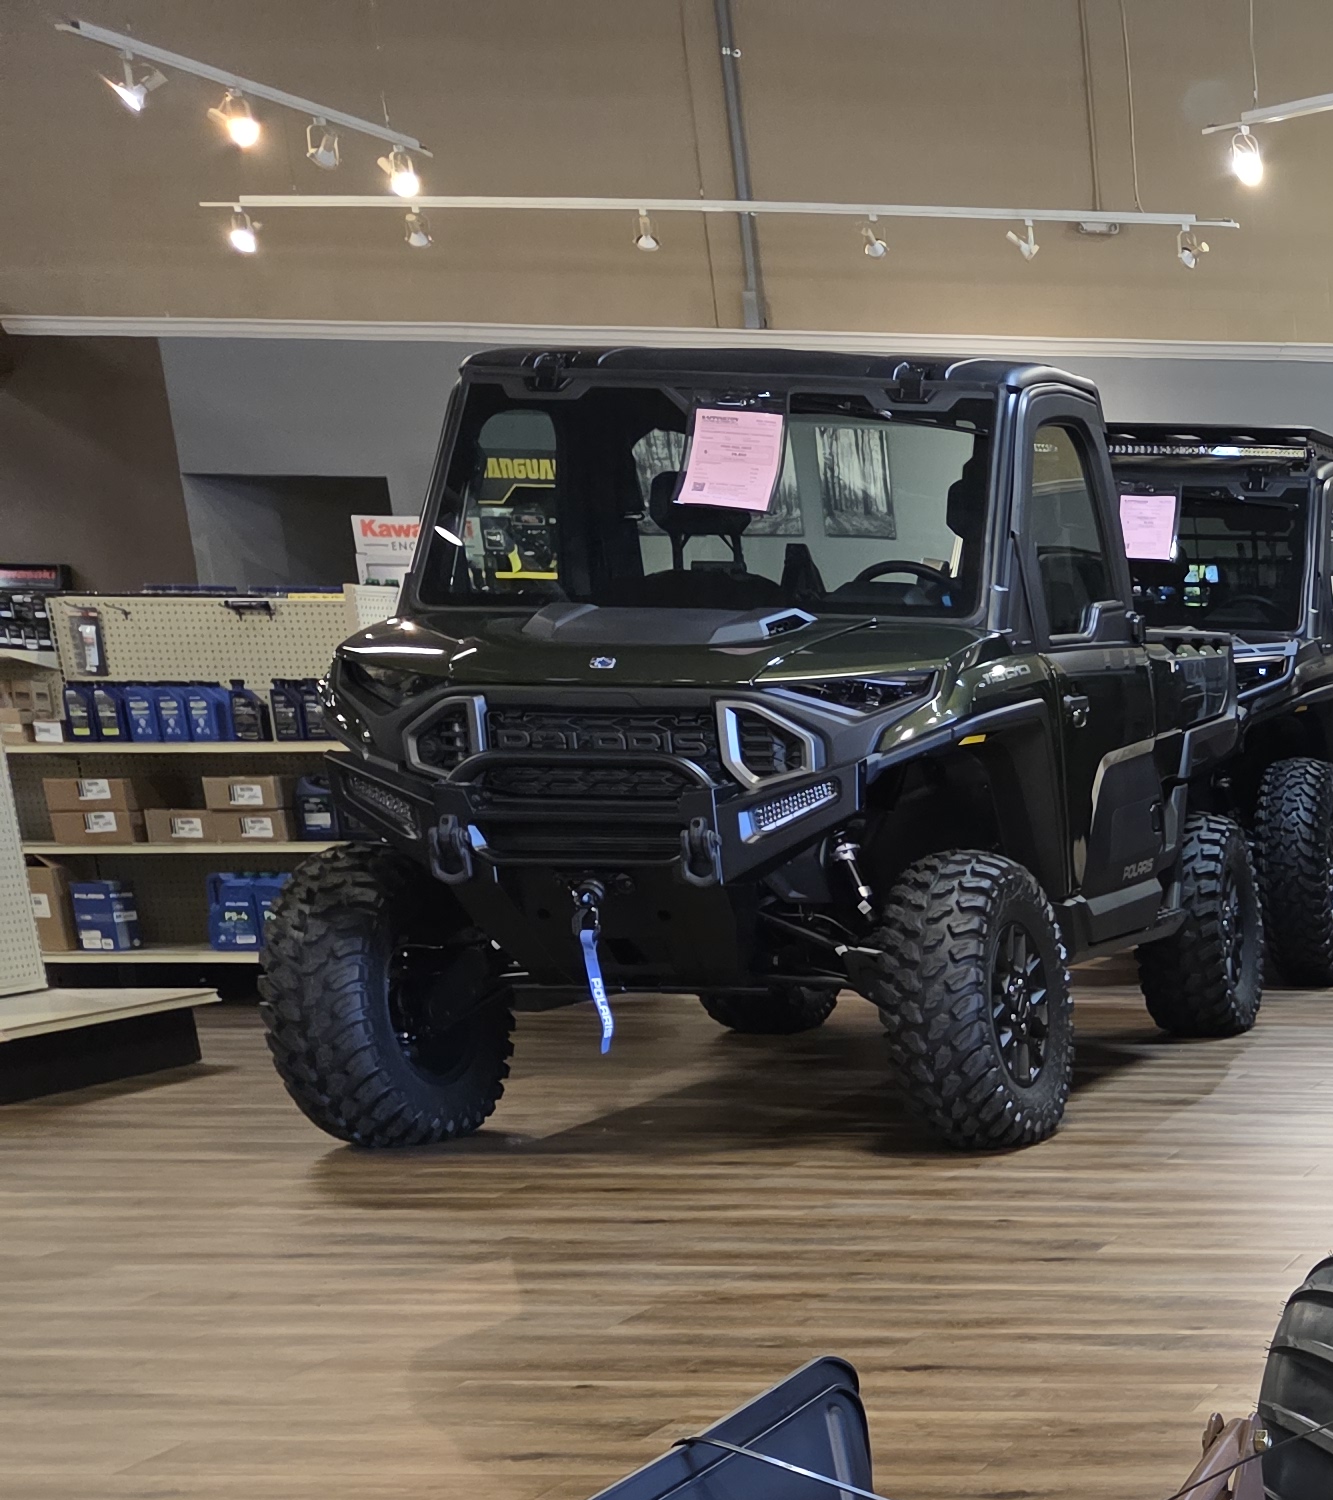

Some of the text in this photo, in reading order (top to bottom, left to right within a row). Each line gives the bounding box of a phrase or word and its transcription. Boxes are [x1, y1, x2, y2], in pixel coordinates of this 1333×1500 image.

[484, 457, 556, 480] ANGUA
[1123, 857, 1155, 880] POLARIS
[591, 977, 614, 1039] POLARIS
